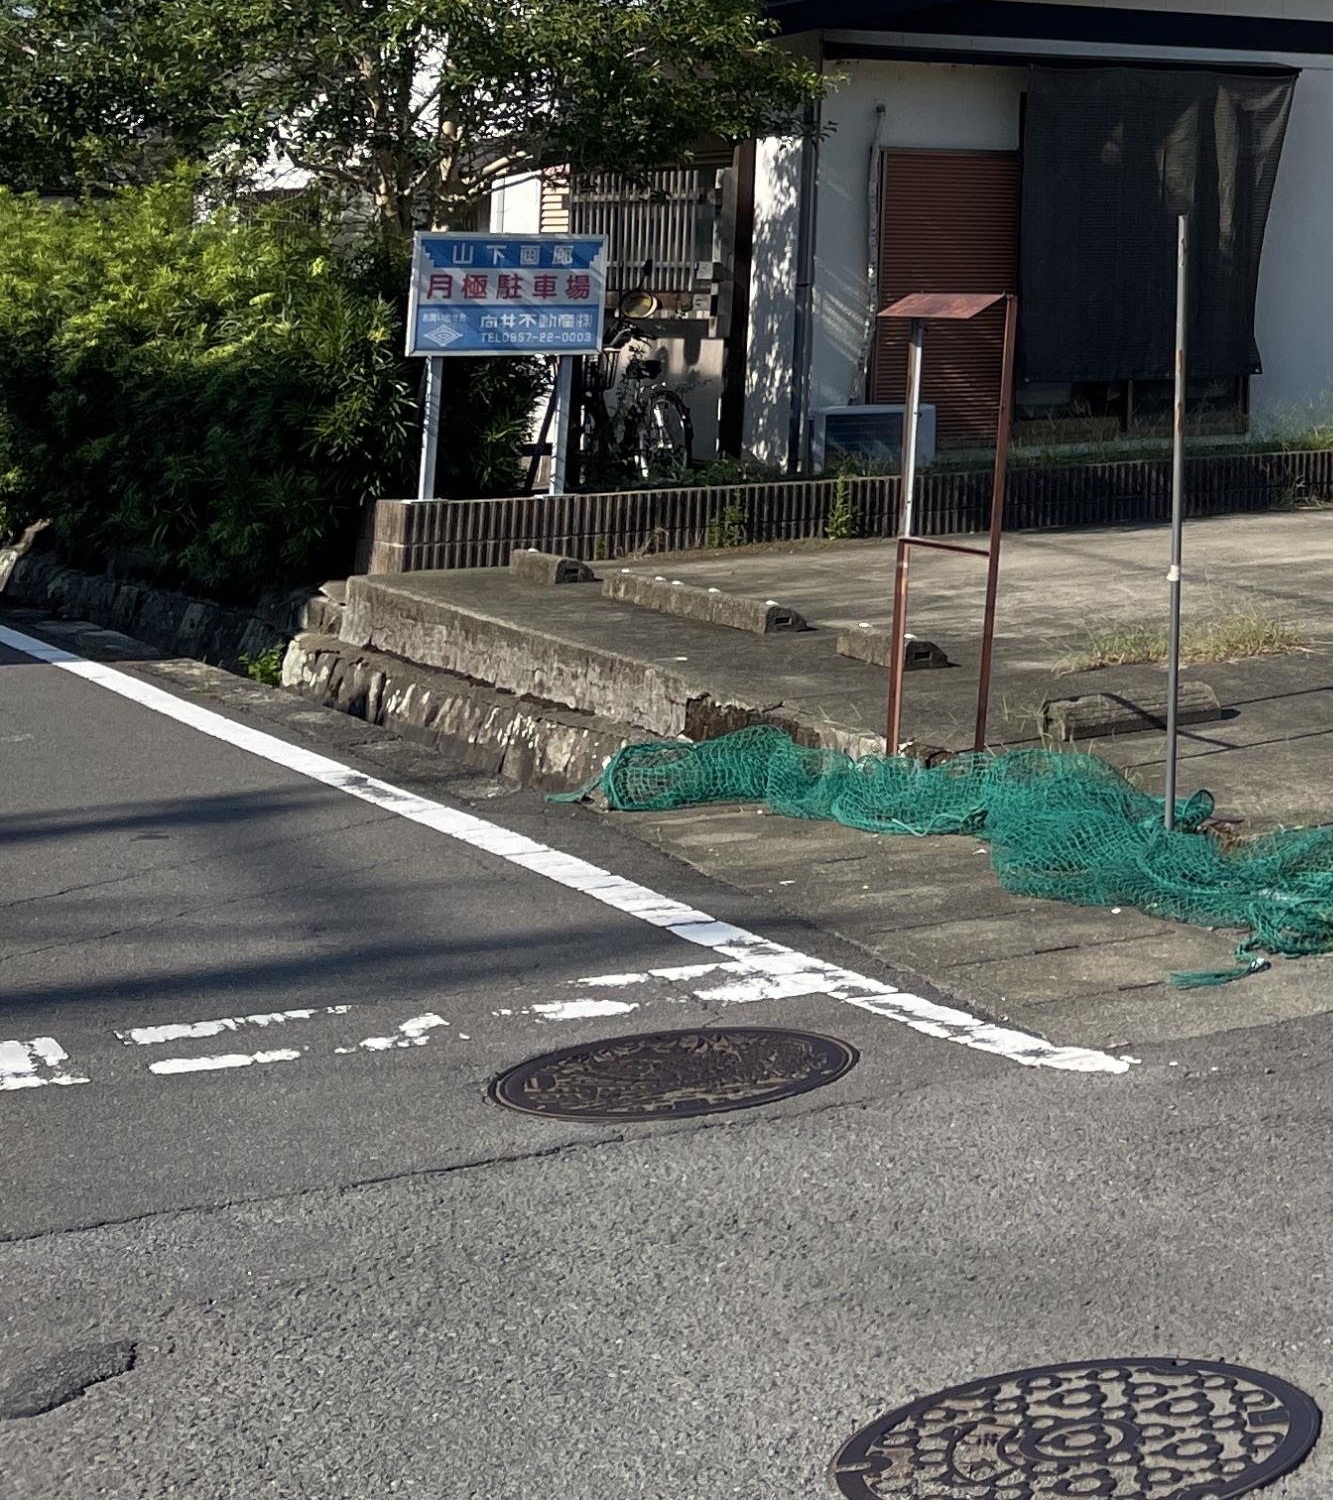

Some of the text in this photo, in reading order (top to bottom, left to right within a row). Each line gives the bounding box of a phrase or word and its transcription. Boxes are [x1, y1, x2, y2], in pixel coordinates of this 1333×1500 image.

[452, 243, 575, 265] 山下画廊
[426, 273, 591, 300] 月極駐車場
